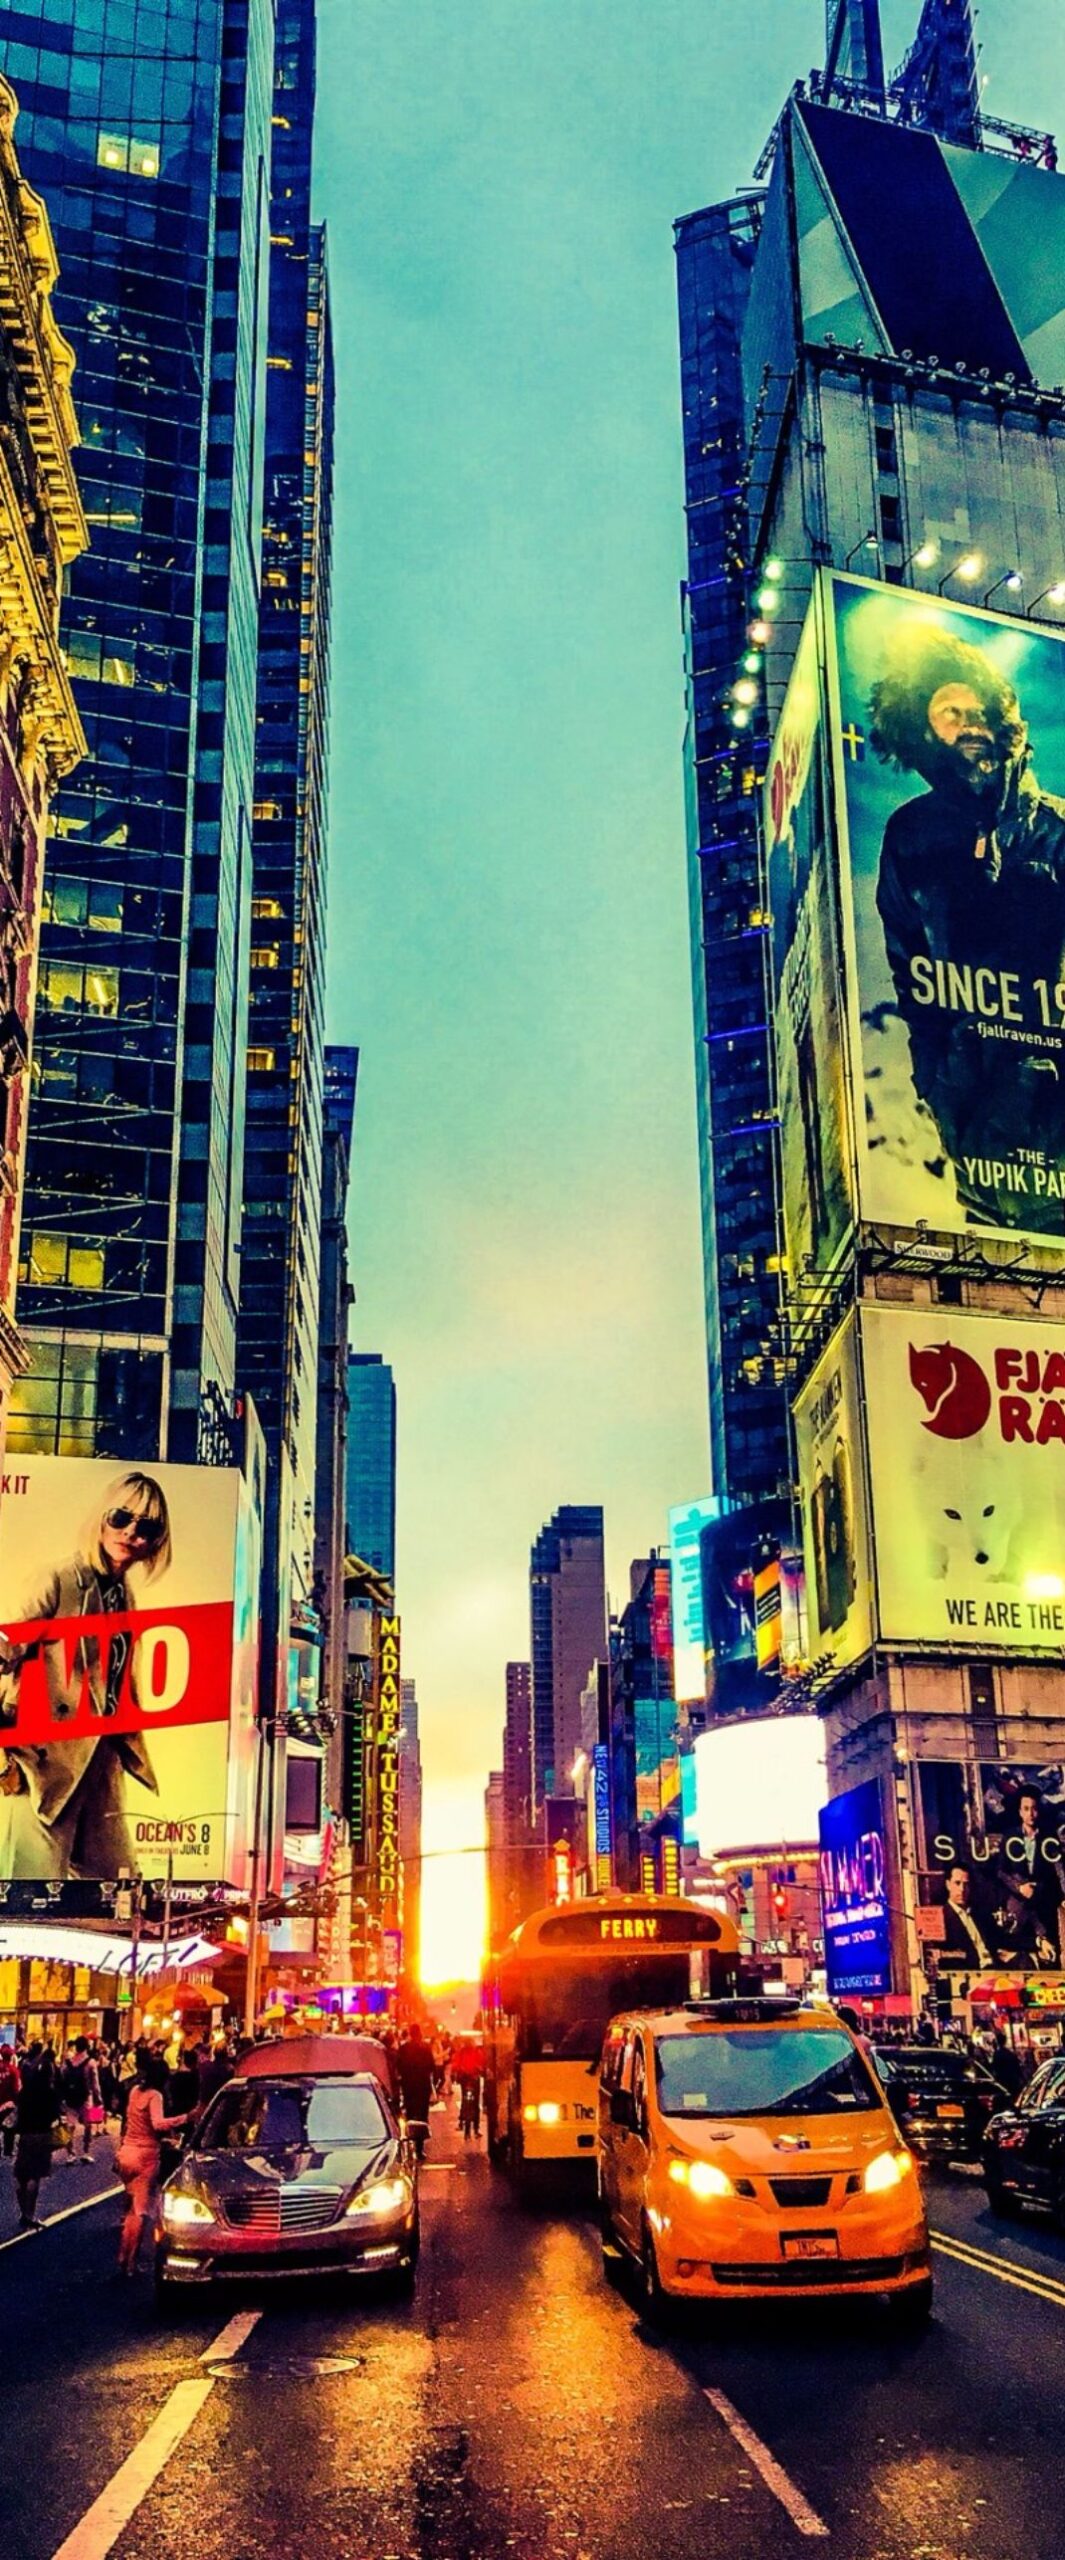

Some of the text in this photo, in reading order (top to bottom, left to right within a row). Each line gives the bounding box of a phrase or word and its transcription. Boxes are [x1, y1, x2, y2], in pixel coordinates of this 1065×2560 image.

[910, 955, 1023, 1022] SINCE
[977, 1021, 1062, 1048] fjallraven.us
[1016, 1147, 1046, 1166] THE
[963, 1156, 1028, 1193] YUPIK
[15, 1475, 30, 1494] IT
[945, 1598, 1064, 1630] WE ARE THE
[380, 1615, 399, 1732] MADAME
[136, 1822, 210, 1843] OCEAN'S 8
[934, 1835, 1062, 1863] SUCC
[600, 1918, 657, 1938] FERRY
[573, 2103, 594, 2120] The
